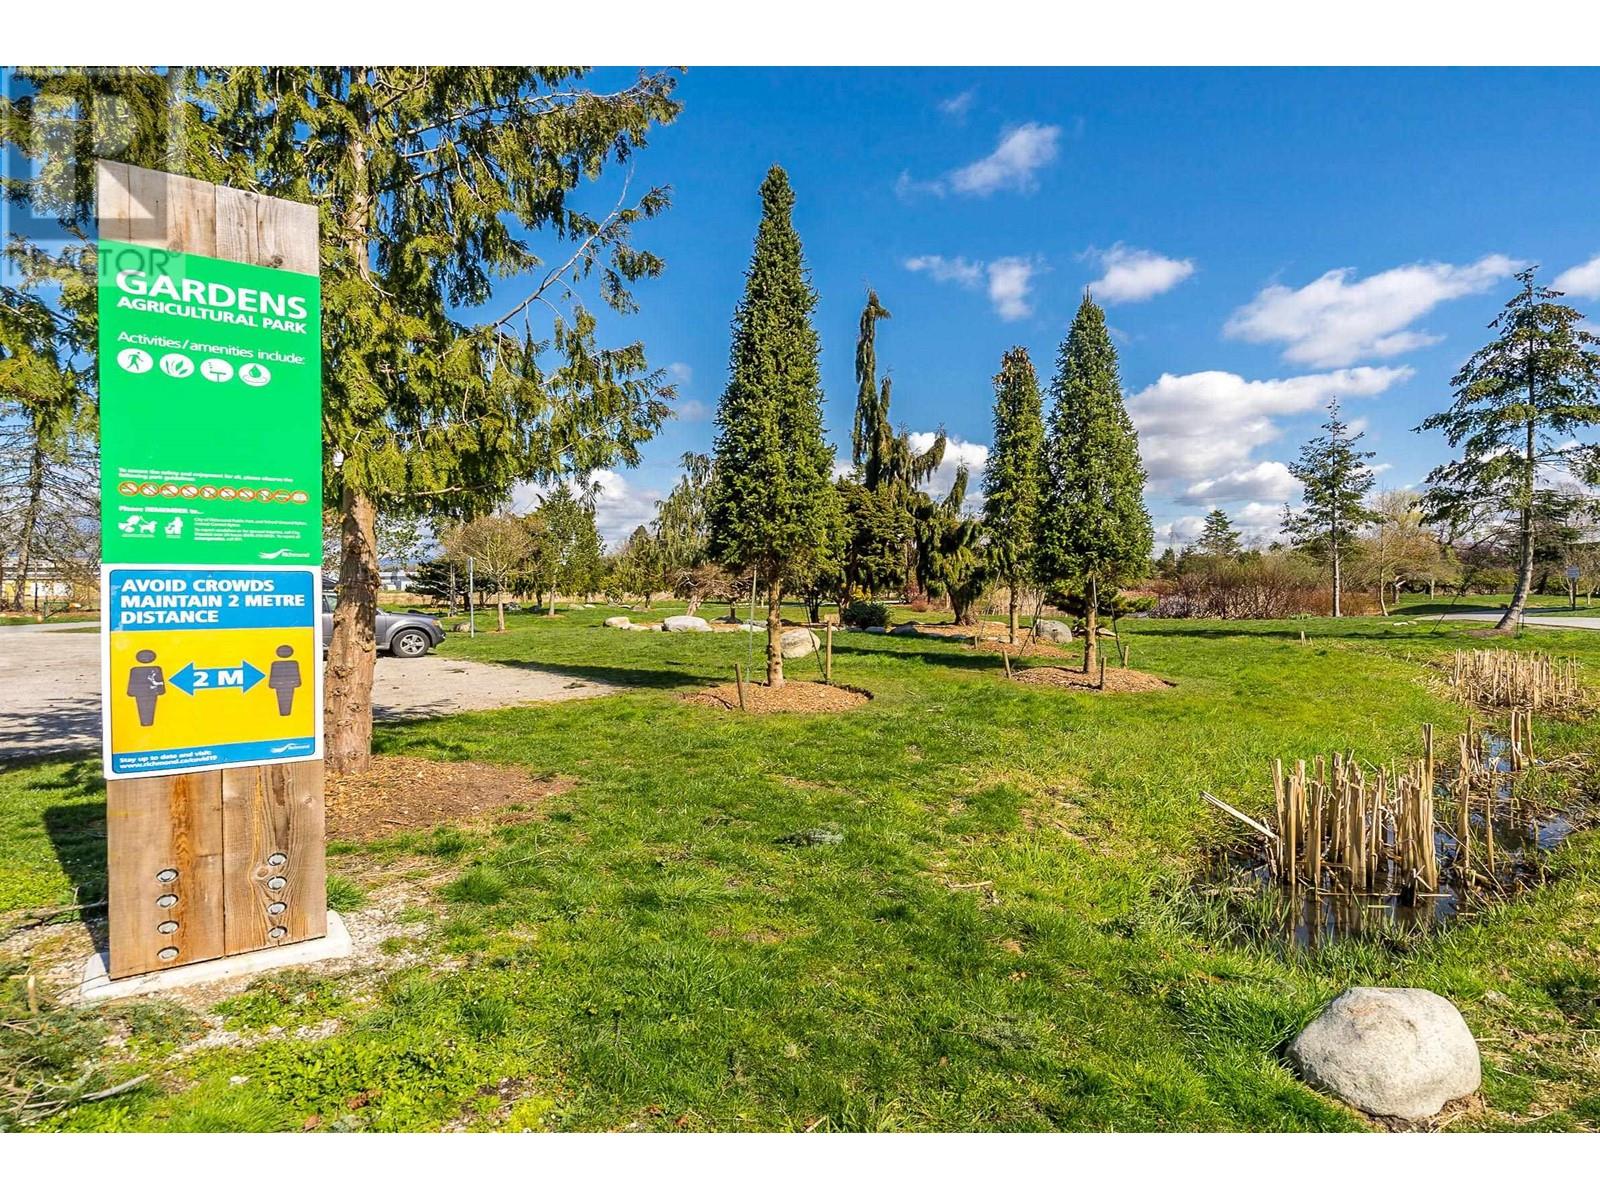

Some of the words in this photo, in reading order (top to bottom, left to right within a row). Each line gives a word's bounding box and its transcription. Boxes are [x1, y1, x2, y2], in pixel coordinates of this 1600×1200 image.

[116, 268, 307, 319] GARDENS
[117, 296, 258, 327] AGRICULTURAL
[262, 317, 307, 334] PARK
[257, 348, 305, 365] include:
[120, 579, 187, 592] AVOID
[193, 579, 275, 592] CROWDS
[120, 595, 223, 608] MAINTAIN
[228, 595, 239, 607] 2
[245, 594, 305, 607] METRE
[120, 610, 219, 625] DISTANCE
[193, 671, 209, 687] 2
[218, 669, 243, 686] M
